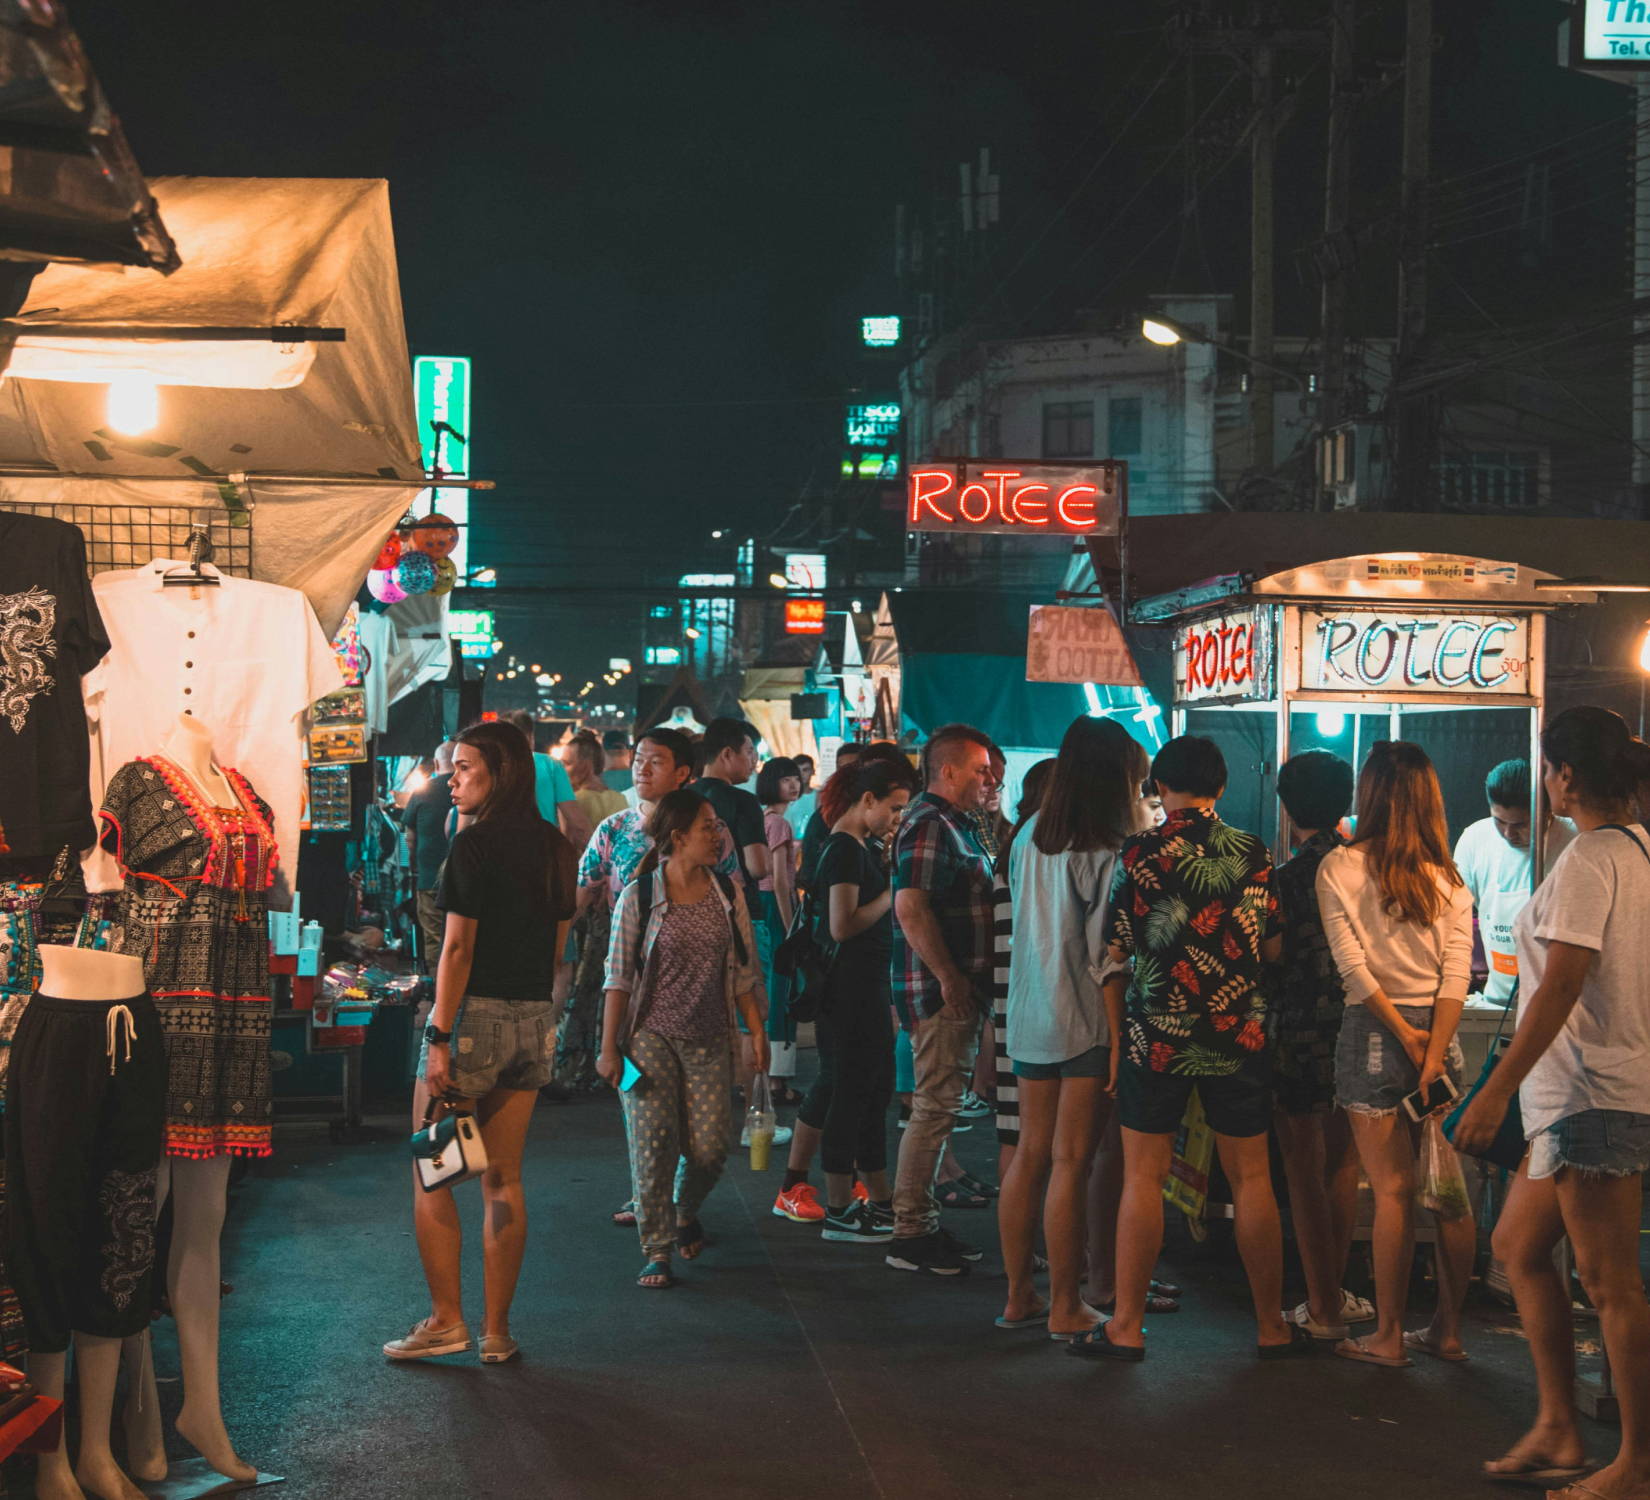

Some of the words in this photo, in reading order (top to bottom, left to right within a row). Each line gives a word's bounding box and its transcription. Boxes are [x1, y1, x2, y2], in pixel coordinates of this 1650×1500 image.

[1602, 0, 1650, 23] Th
[1608, 40, 1640, 55] Tel.
[847, 421, 898, 436] Lotus
[1317, 618, 1516, 688] ROTEE
